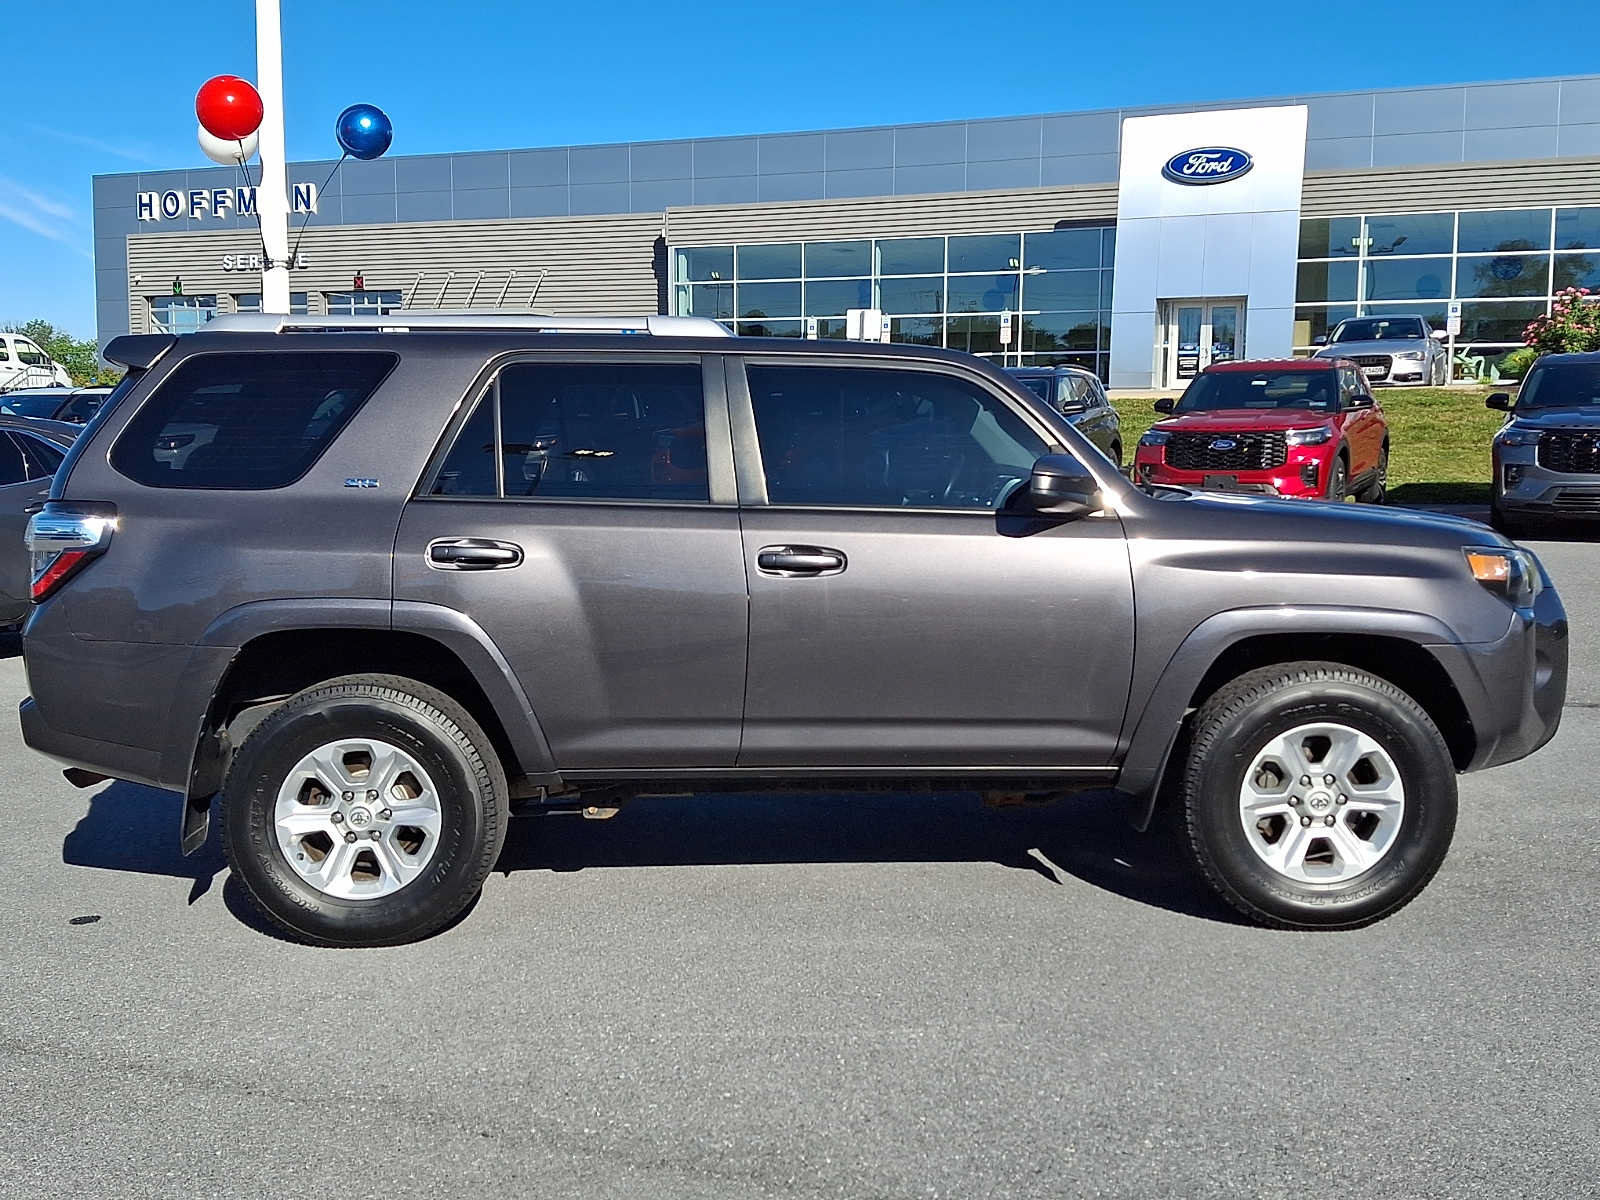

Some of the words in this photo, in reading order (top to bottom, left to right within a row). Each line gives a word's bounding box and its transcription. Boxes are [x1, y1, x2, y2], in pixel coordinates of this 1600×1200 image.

[1183, 153, 1233, 174] Ford
[137, 184, 314, 219] HOFFMN
[223, 252, 309, 271] SERE
